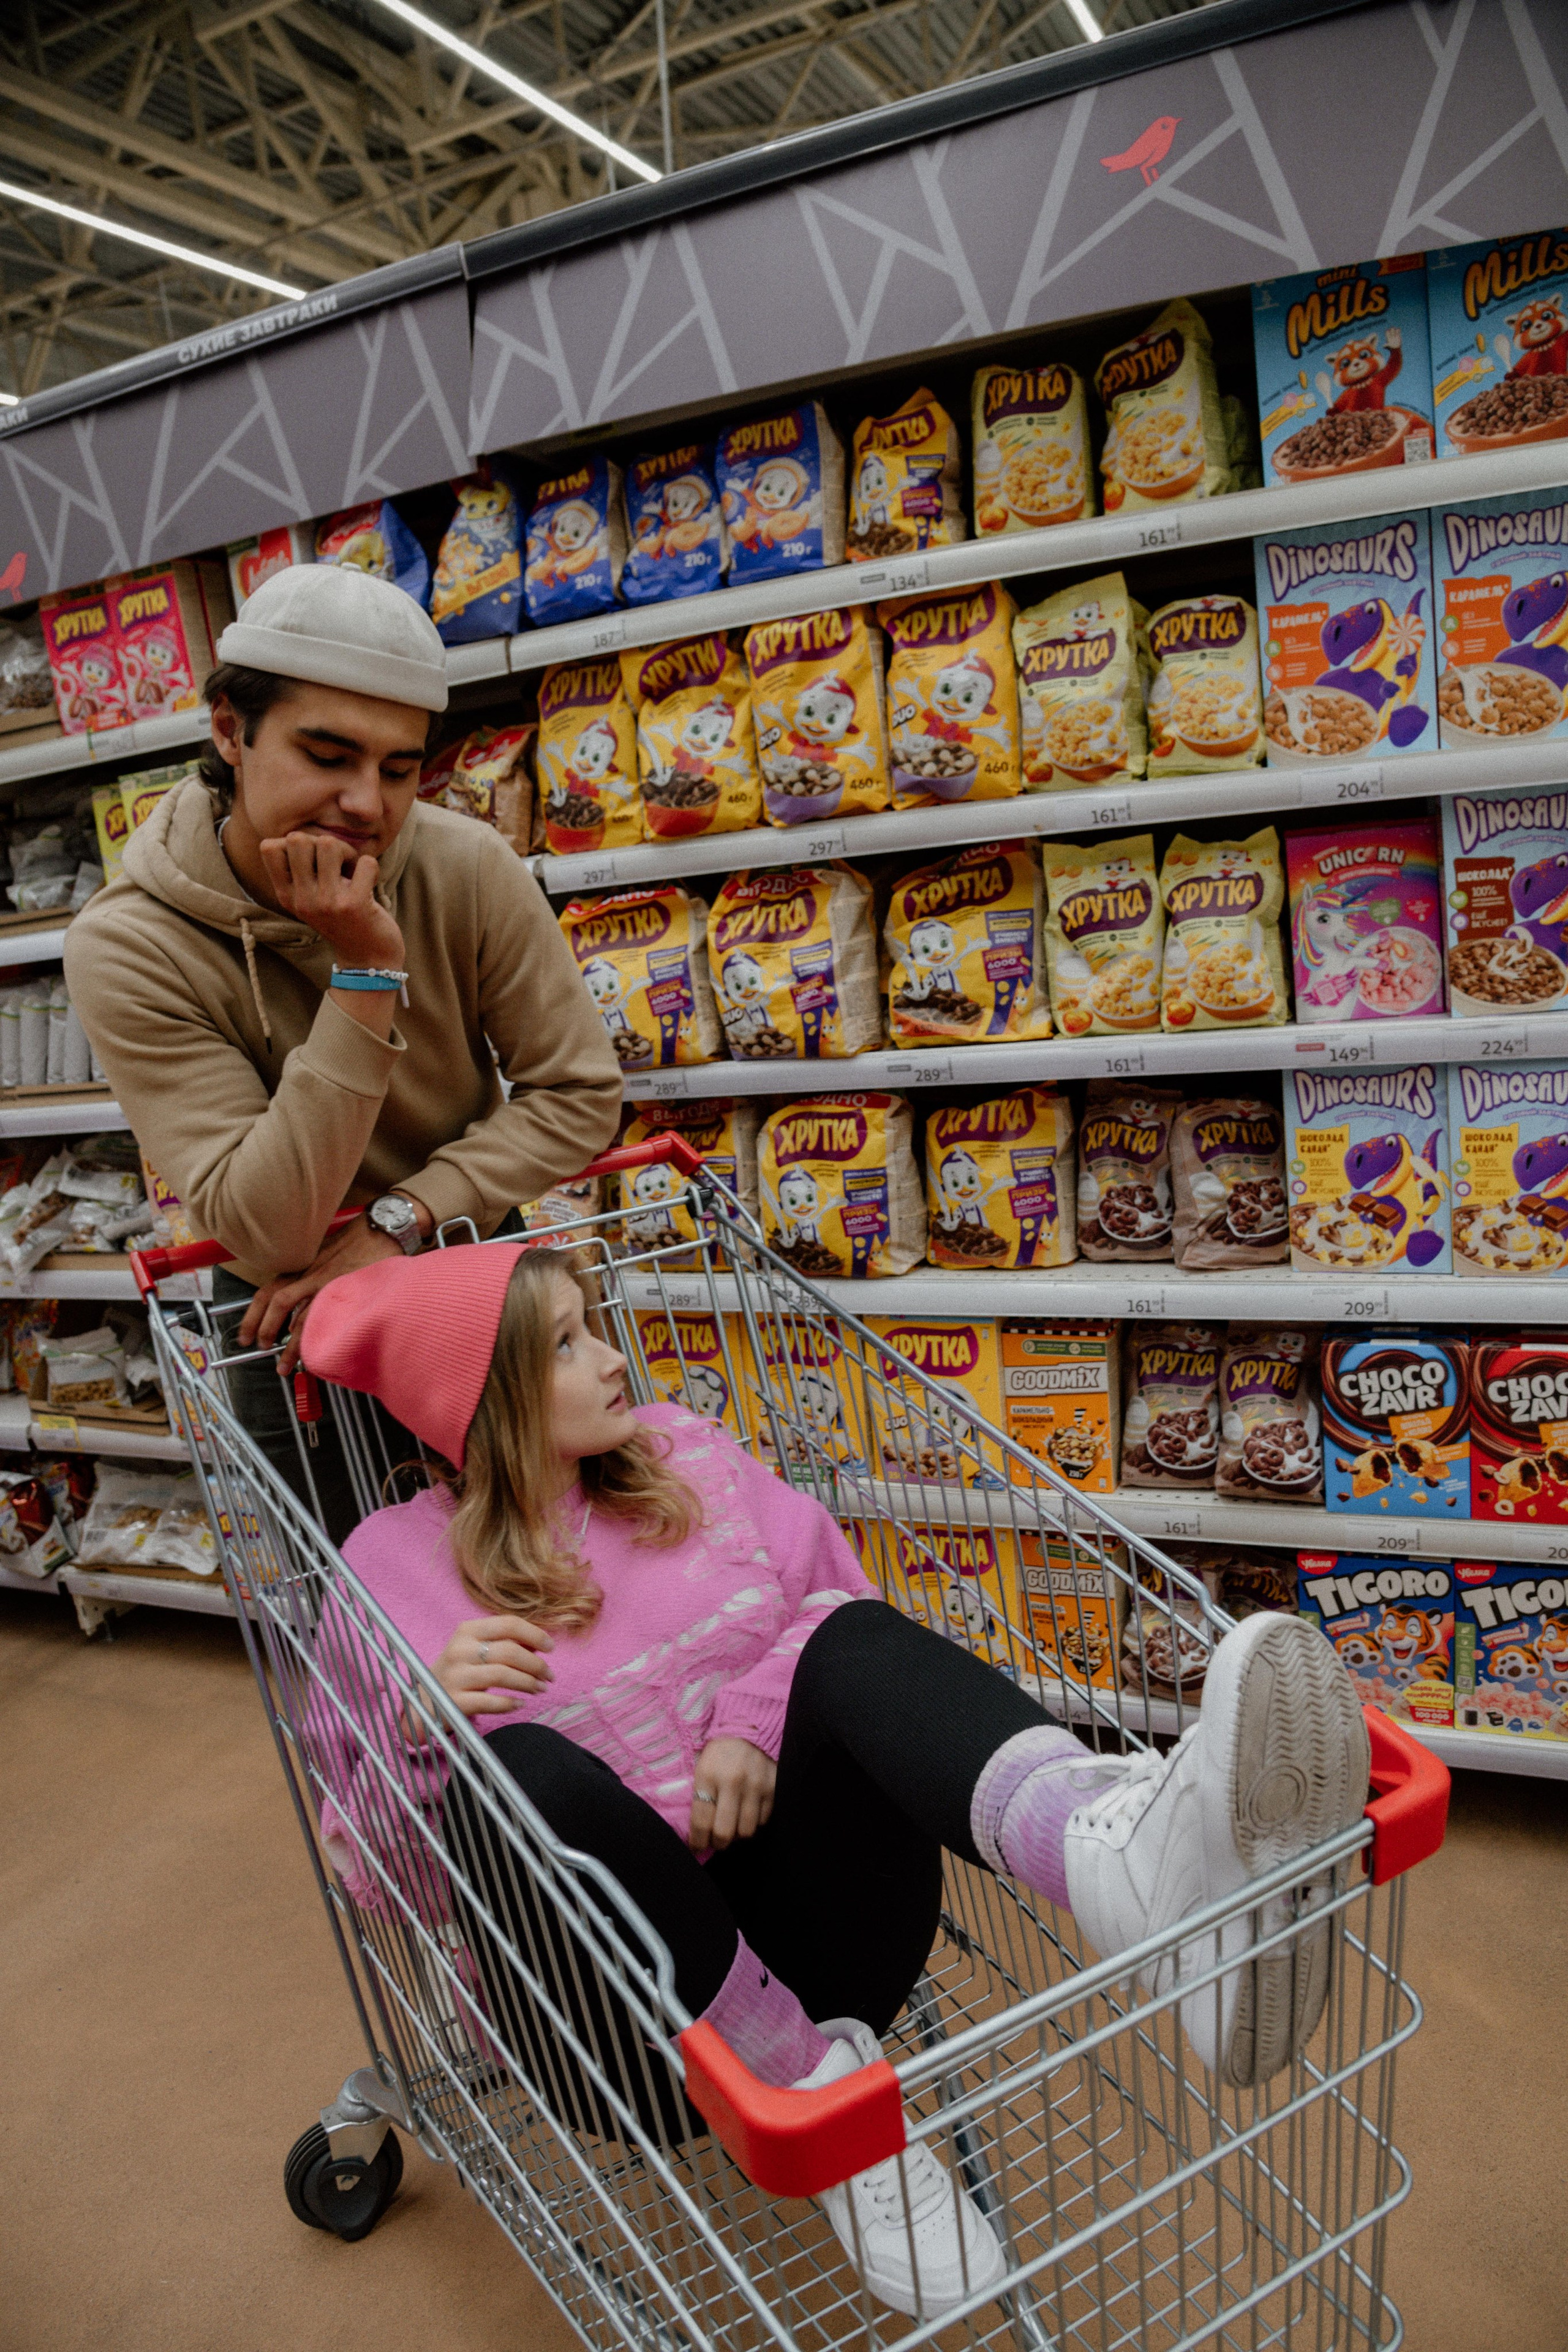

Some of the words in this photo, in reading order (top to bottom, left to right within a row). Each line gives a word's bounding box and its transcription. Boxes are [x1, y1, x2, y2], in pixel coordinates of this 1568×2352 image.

[1288, 280, 1389, 358] Mills
[178, 337, 238, 364] СУХИЕ
[244, 296, 337, 340] ЗАВТРАКИ
[987, 375, 1066, 415] ХРУТКА
[728, 417, 797, 457] ХРУТКА
[1139, 530, 1167, 546] 161
[1444, 505, 1568, 575] DiNOSAU
[783, 542, 804, 558] 210
[685, 553, 705, 568] 210
[575, 575, 595, 590] 210
[891, 576, 916, 590] 134
[119, 587, 168, 631] ХРУТКА
[55, 607, 106, 643] ХРУТКА
[894, 594, 989, 641] ХРУТКА
[594, 633, 614, 647] 187
[754, 610, 846, 666] ХРУТКА
[1154, 612, 1240, 652] ХРУТКА
[1025, 639, 1109, 675] ХРУТКА
[984, 763, 1008, 773] 460
[850, 778, 873, 790] 460
[1338, 783, 1369, 797] 204
[728, 794, 747, 804] 460
[1091, 810, 1116, 824] 161
[1455, 794, 1568, 854] DiNOSAU
[809, 842, 834, 856] 297
[583, 872, 605, 884] 297
[1457, 869, 1510, 883] ШОКОЛАД
[911, 867, 1005, 914] ХРУТКА
[1172, 880, 1256, 912] ХРУТКА
[1472, 886, 1498, 897] 100%
[1060, 889, 1146, 932] ХРУТКА
[717, 895, 808, 944] ХРУТКА
[575, 907, 664, 954] ХРУТКА
[987, 957, 1017, 970] 6000
[1330, 1048, 1360, 1062] 149
[1482, 1042, 1513, 1054] 224
[1106, 1059, 1131, 1072] 161
[915, 1069, 941, 1082] 289
[654, 1082, 676, 1095] 289
[1294, 1065, 1436, 1123] DiNOSAURS
[938, 1097, 1028, 1138] ХРУТКА
[777, 1118, 858, 1156] ХРУТКА
[1085, 1121, 1158, 1155] ХРУТКА
[1197, 1121, 1276, 1152] ХРУТКА
[1465, 1134, 1513, 1142] ШОКОЛАД
[1014, 1196, 1041, 1207] 6000
[845, 1215, 872, 1226] 6000
[669, 1295, 690, 1306] 289
[1128, 1300, 1152, 1313] 161
[1345, 1302, 1374, 1316] 209
[1140, 1349, 1215, 1377] ХРУТКА
[1012, 1367, 1100, 1390] GOODMiX
[1340, 1361, 1445, 1397] CHOCO
[1360, 1385, 1439, 1416] ZAVR
[886, 1416, 908, 1430] DUO
[1164, 1522, 1187, 1533] 161
[1378, 1537, 1406, 1549] 209
[1305, 1570, 1450, 1618] TIGORO
[1461, 1579, 1568, 1629] TIGO
